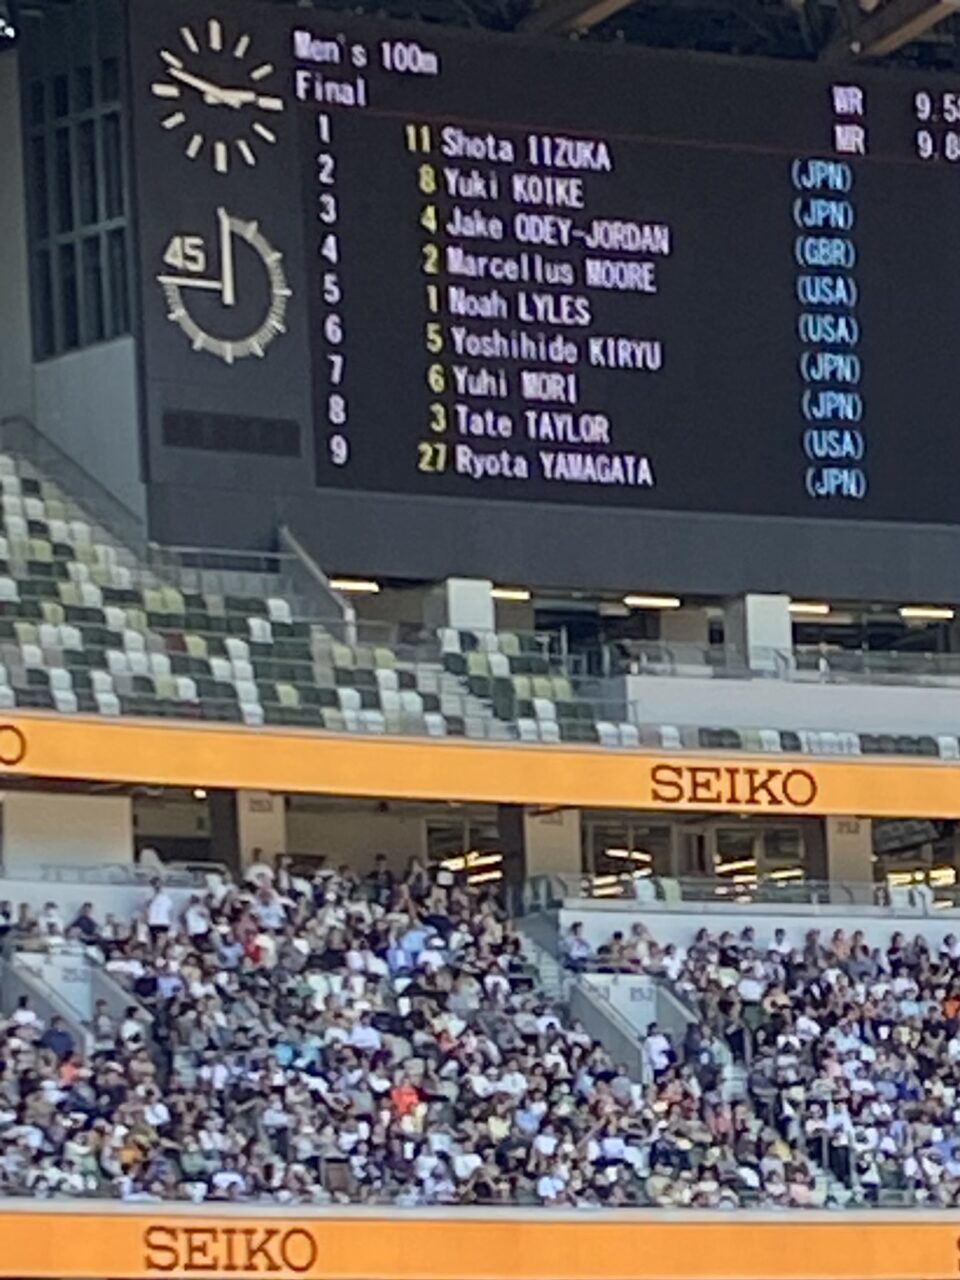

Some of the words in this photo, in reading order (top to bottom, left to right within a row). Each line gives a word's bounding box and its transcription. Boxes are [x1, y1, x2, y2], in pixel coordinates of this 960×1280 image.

[296, 70, 366, 106] Final
[382, 42, 438, 74] 100m
[318, 115, 330, 142] 1
[407, 125, 430, 153] 11
[441, 126, 515, 162] Shota
[527, 135, 612, 172] IIZUKA
[791, 159, 852, 193] (JPN)
[319, 154, 335, 184] 2
[419, 164, 436, 194] 8
[443, 167, 498, 199] Yuki
[512, 174, 585, 208] KOIKE
[793, 197, 854, 231] (JPN)
[163, 236, 206, 272] 45
[320, 194, 336, 224] 3
[420, 205, 437, 234] 4
[446, 206, 503, 240] Jake
[514, 213, 669, 255] ODEY-JORDAN
[795, 236, 856, 269] (GBR)
[322, 235, 338, 264] 4
[422, 243, 438, 274] 2
[446, 246, 574, 285] Marcellus
[586, 257, 656, 292] MOORE
[798, 275, 858, 307] (USA)
[323, 273, 340, 304] 5
[427, 286, 438, 313] 1
[448, 286, 507, 320] Noah
[518, 292, 591, 327] LYLES
[799, 314, 859, 346] (USA)
[325, 314, 342, 344] 6
[426, 323, 443, 353] 5
[450, 326, 579, 364] Yoshihide
[590, 337, 664, 370] KIRYU
[800, 352, 861, 384] (JPN)
[327, 354, 343, 384] 7
[428, 364, 445, 393] 6
[452, 365, 507, 399] Yuhi
[521, 371, 578, 404] MORI
[802, 391, 862, 422] (JPN)
[329, 394, 346, 424] 8
[430, 403, 447, 433] 3
[456, 404, 512, 438] Tate
[525, 411, 610, 443] TAYLOR
[804, 429, 865, 461] (USA)
[330, 434, 347, 465] 9
[418, 442, 447, 472] 27
[456, 444, 529, 479] Ryota
[539, 451, 655, 487] YAMAGATA
[806, 467, 867, 499] (JPN)
[651, 764, 818, 807] SEIKO
[143, 1225, 318, 1273] SEIKO
